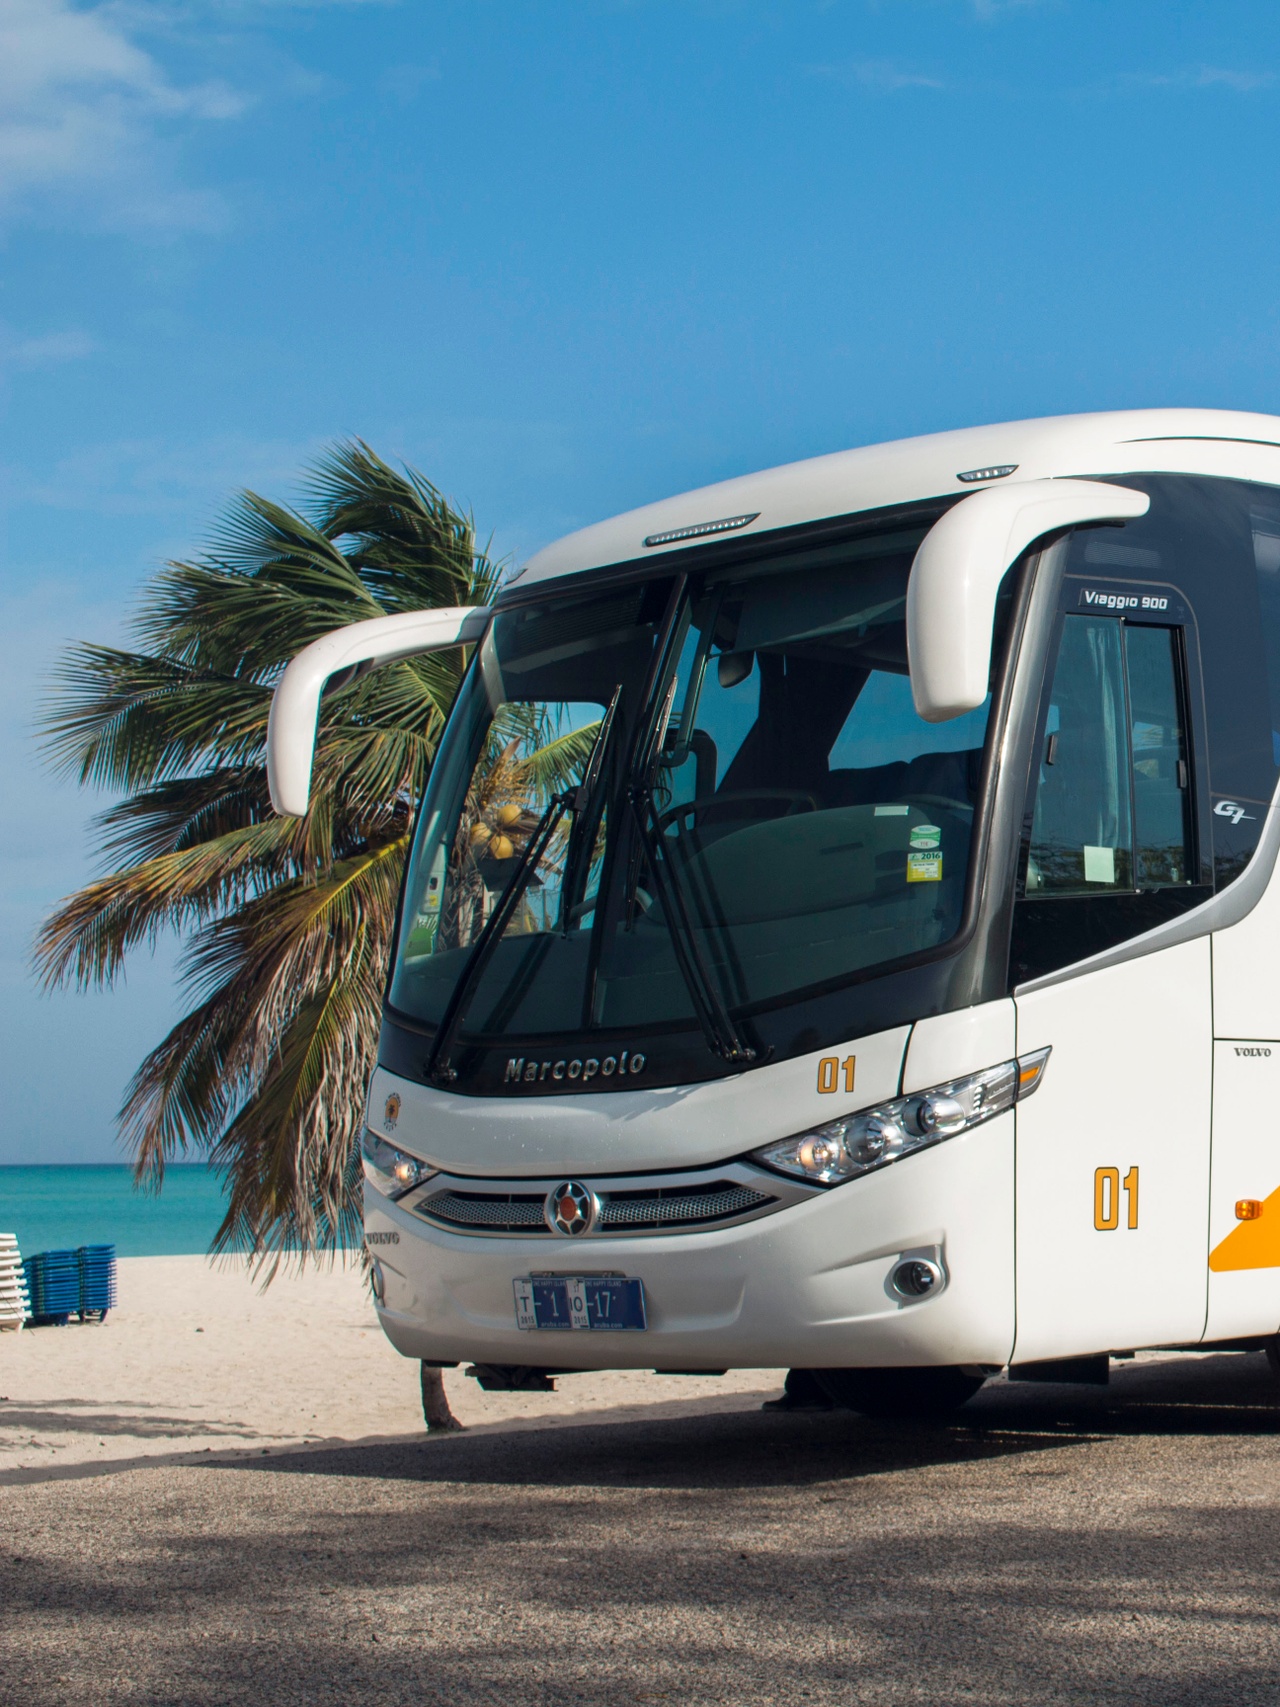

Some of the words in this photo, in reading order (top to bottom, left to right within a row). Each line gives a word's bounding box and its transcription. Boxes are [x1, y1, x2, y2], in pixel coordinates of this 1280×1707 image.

[1085, 590, 1138, 609] Viaggio
[1142, 596, 1168, 610] 900
[921, 852, 940, 860] 2016
[1234, 1047, 1272, 1058] VOLVO
[504, 1050, 646, 1083] Marcopolo
[817, 1055, 857, 1095] 01
[1093, 1166, 1139, 1231] 01
[365, 1231, 400, 1245] VOLVO
[574, 1316, 587, 1324] 2015
